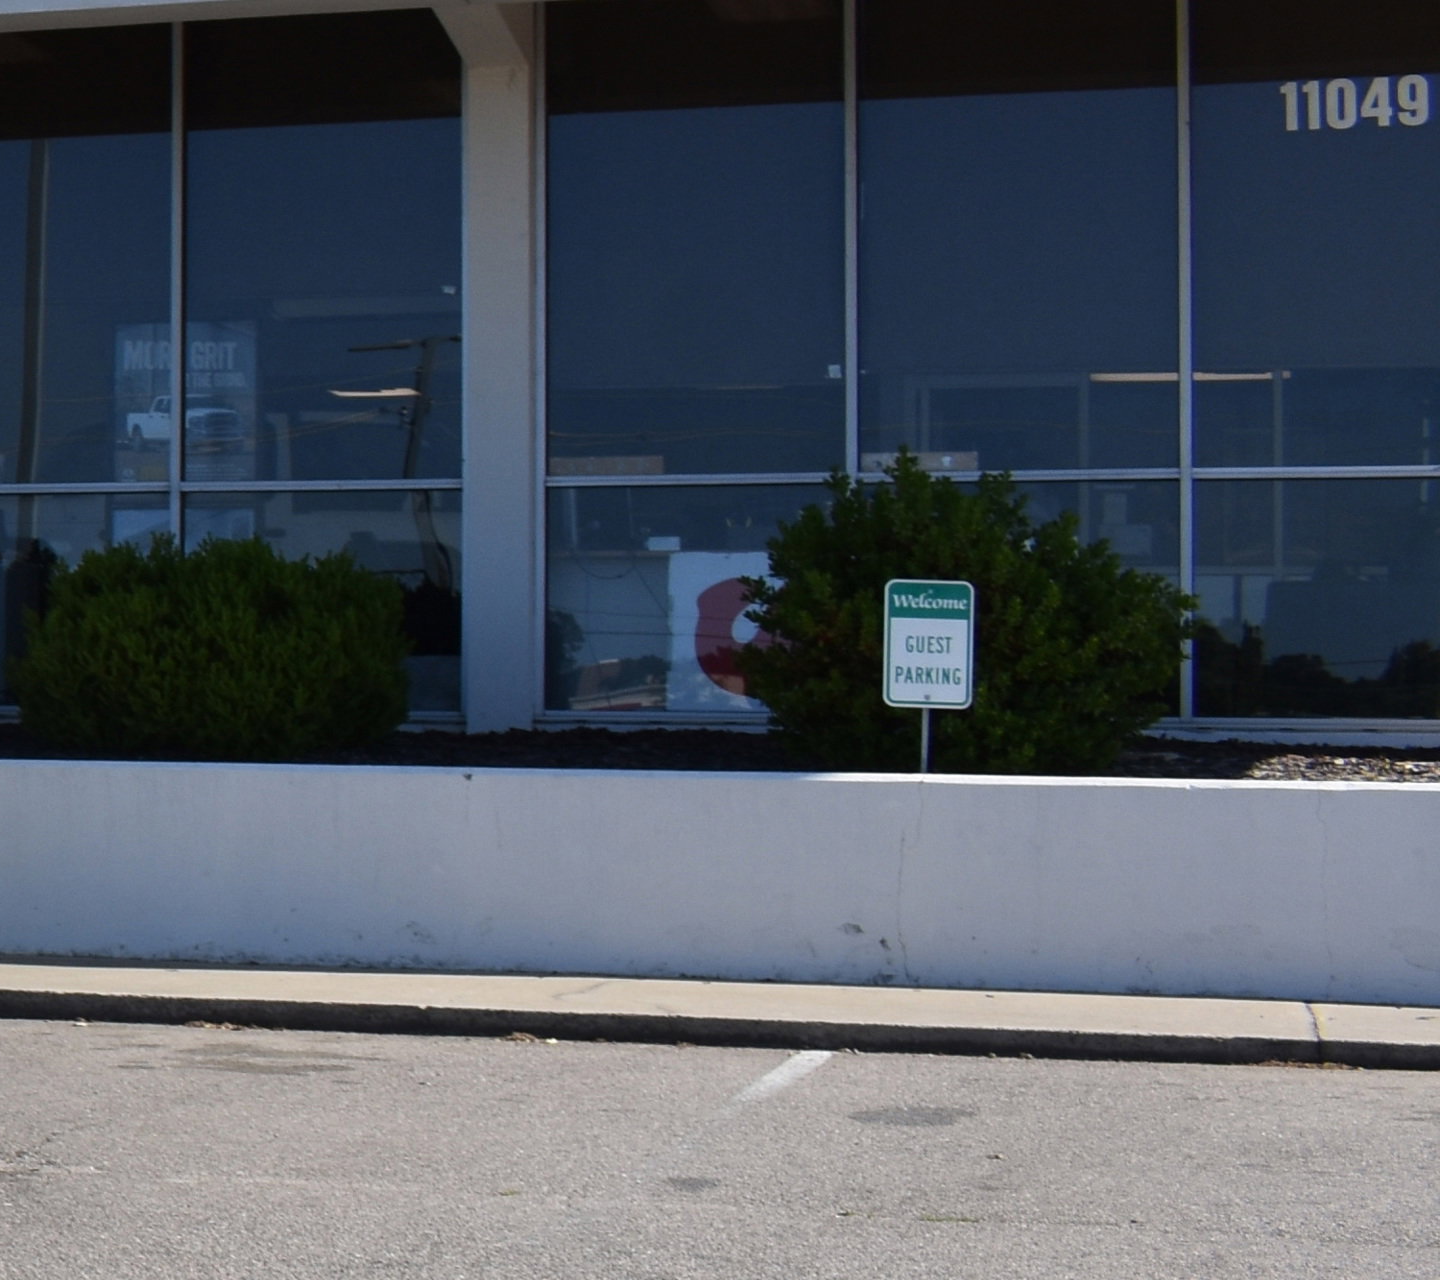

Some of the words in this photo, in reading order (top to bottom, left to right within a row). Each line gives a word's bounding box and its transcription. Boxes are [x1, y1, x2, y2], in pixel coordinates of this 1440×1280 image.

[1280, 74, 1429, 131] 11049
[123, 340, 172, 370] MOR
[191, 341, 237, 370] GRIT
[893, 593, 968, 610] Welcome
[905, 635, 952, 654] GUEST
[895, 666, 962, 686] PARKING
